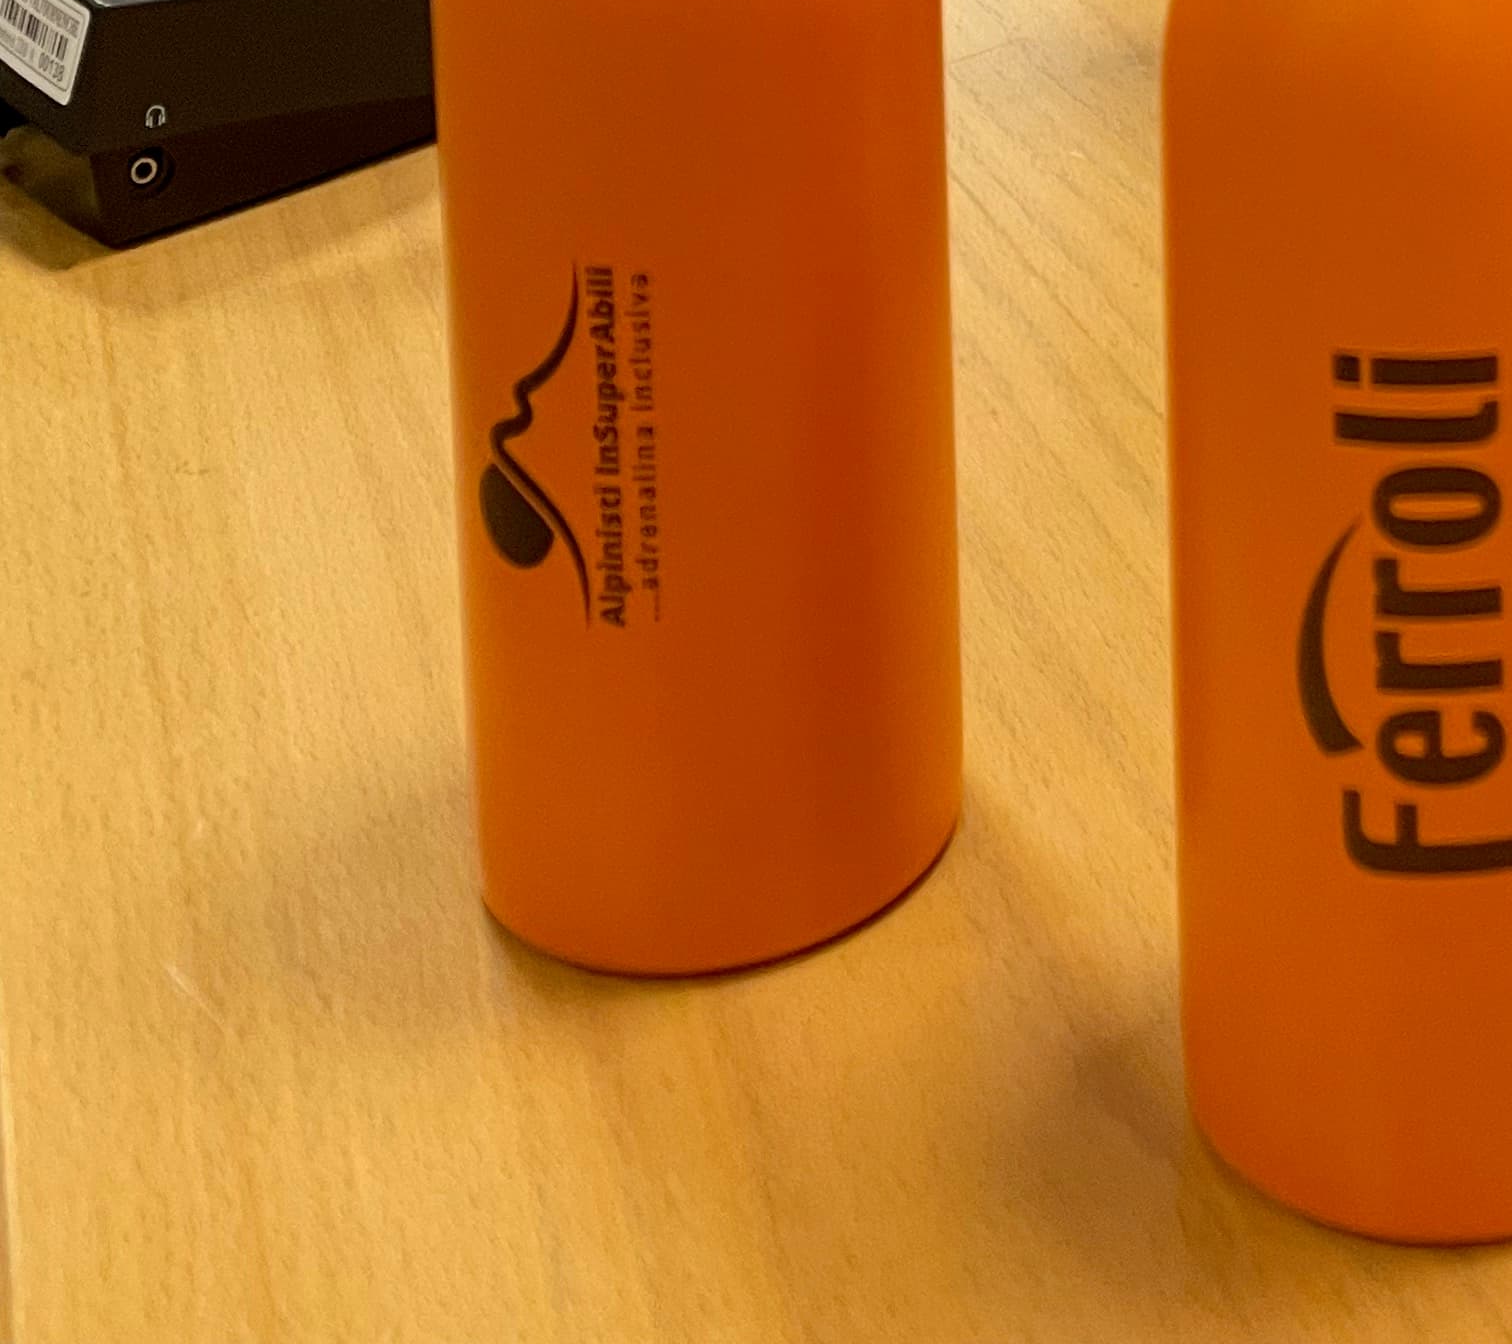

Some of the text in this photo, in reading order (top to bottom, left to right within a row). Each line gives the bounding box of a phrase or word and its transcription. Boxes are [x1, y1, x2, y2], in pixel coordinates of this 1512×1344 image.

[586, 266, 631, 627] Alpinisti InSuperAbili
[625, 272, 656, 412] inclusiva
